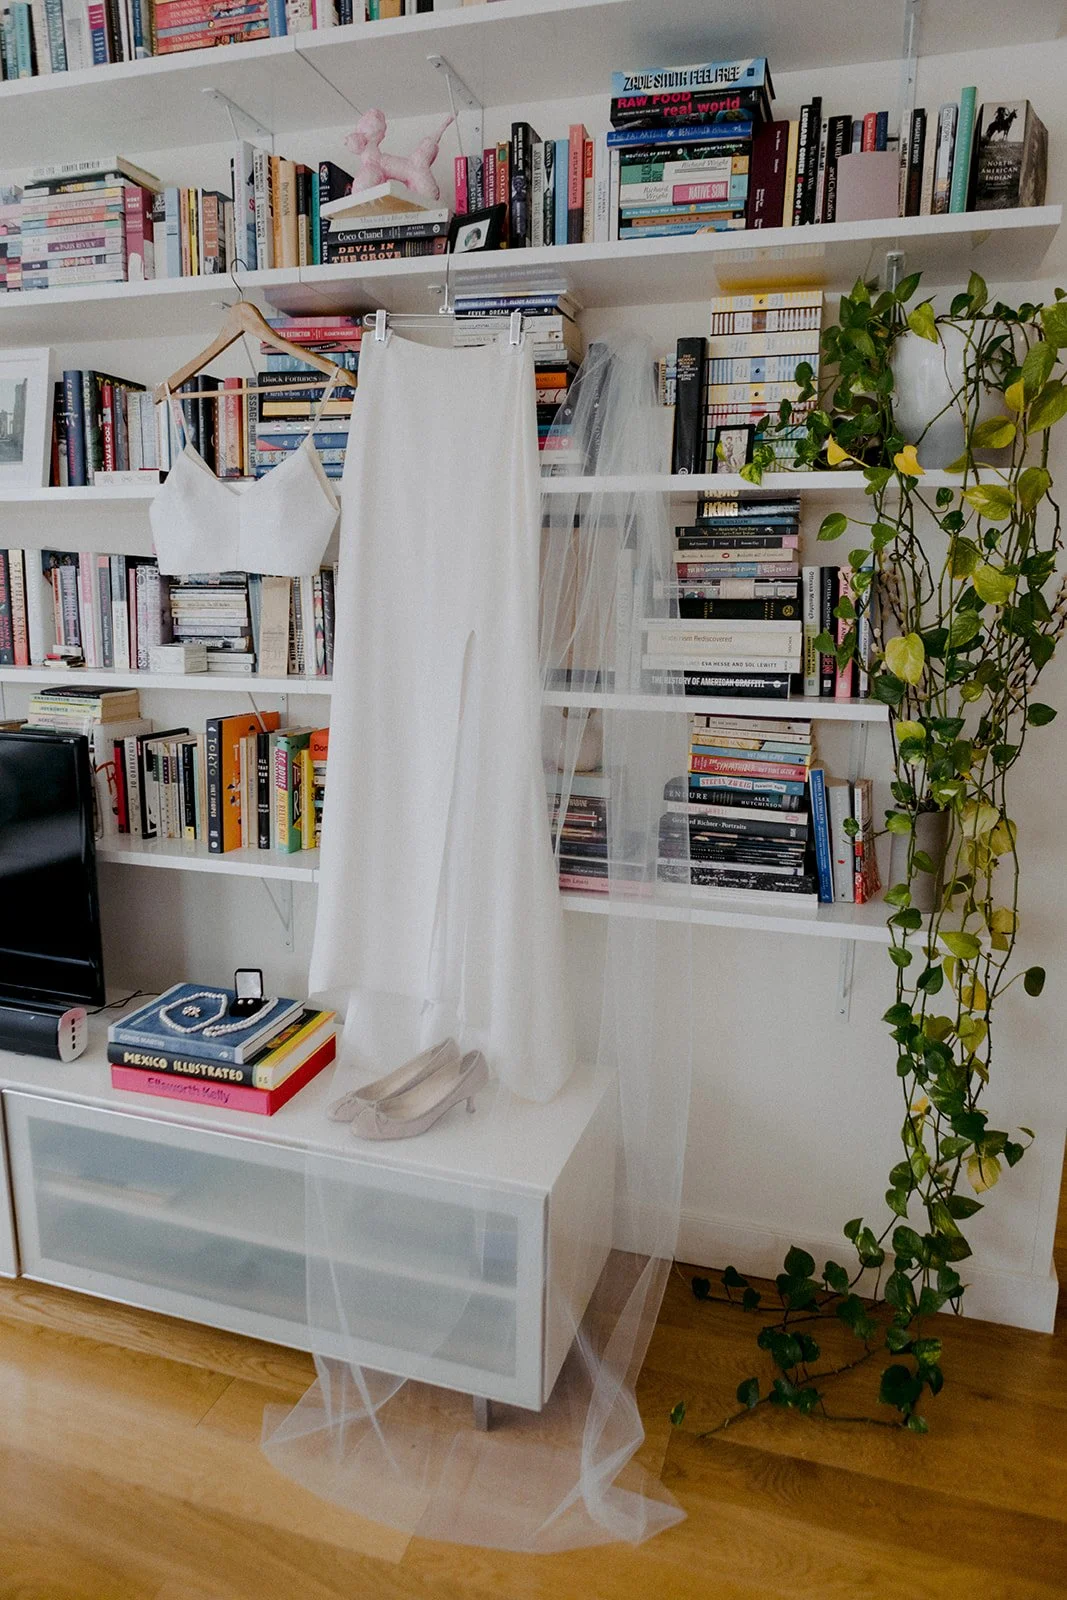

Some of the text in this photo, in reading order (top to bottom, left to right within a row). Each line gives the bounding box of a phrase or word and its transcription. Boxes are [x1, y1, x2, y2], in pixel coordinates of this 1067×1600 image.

[623, 75, 653, 92] ZADIE
[689, 68, 714, 86] FEEL
[715, 66, 741, 83] FREE
[617, 96, 648, 109] RAW
[652, 92, 692, 105] FOOD
[663, 102, 692, 117] real
[697, 97, 740, 113] world
[912, 143, 920, 164] ATWOOD
[681, 158, 729, 169] Richard Wright
[643, 185, 670, 194] Richard
[688, 184, 726, 200] NATIVE SON
[645, 193, 669, 201] Wright
[827, 181, 836, 221] Civilization
[337, 229, 383, 242] Coco Chanel
[339, 245, 376, 254] DEVIL
[332, 251, 402, 263] THE GROVE
[262, 374, 319, 383] Black Fortunes
[248, 382, 258, 422] MSSAGE
[14, 561, 26, 644] STEPHEN KING
[691, 677, 700, 686] OF
[700, 677, 734, 687] AMERICAN
[278, 765, 287, 789] BOYLE
[701, 777, 752, 789] STEFAN ZWEIG
[669, 790, 708, 800] ENDURE
[741, 800, 782, 808] HUTCHINSON
[699, 819, 718, 827] Richter
[722, 821, 747, 830] Portraits
[123, 1052, 168, 1069] MEXICO
[173, 1060, 244, 1081] ILLUSTRATED
[147, 1077, 231, 1103] Ellsworth Kelly
